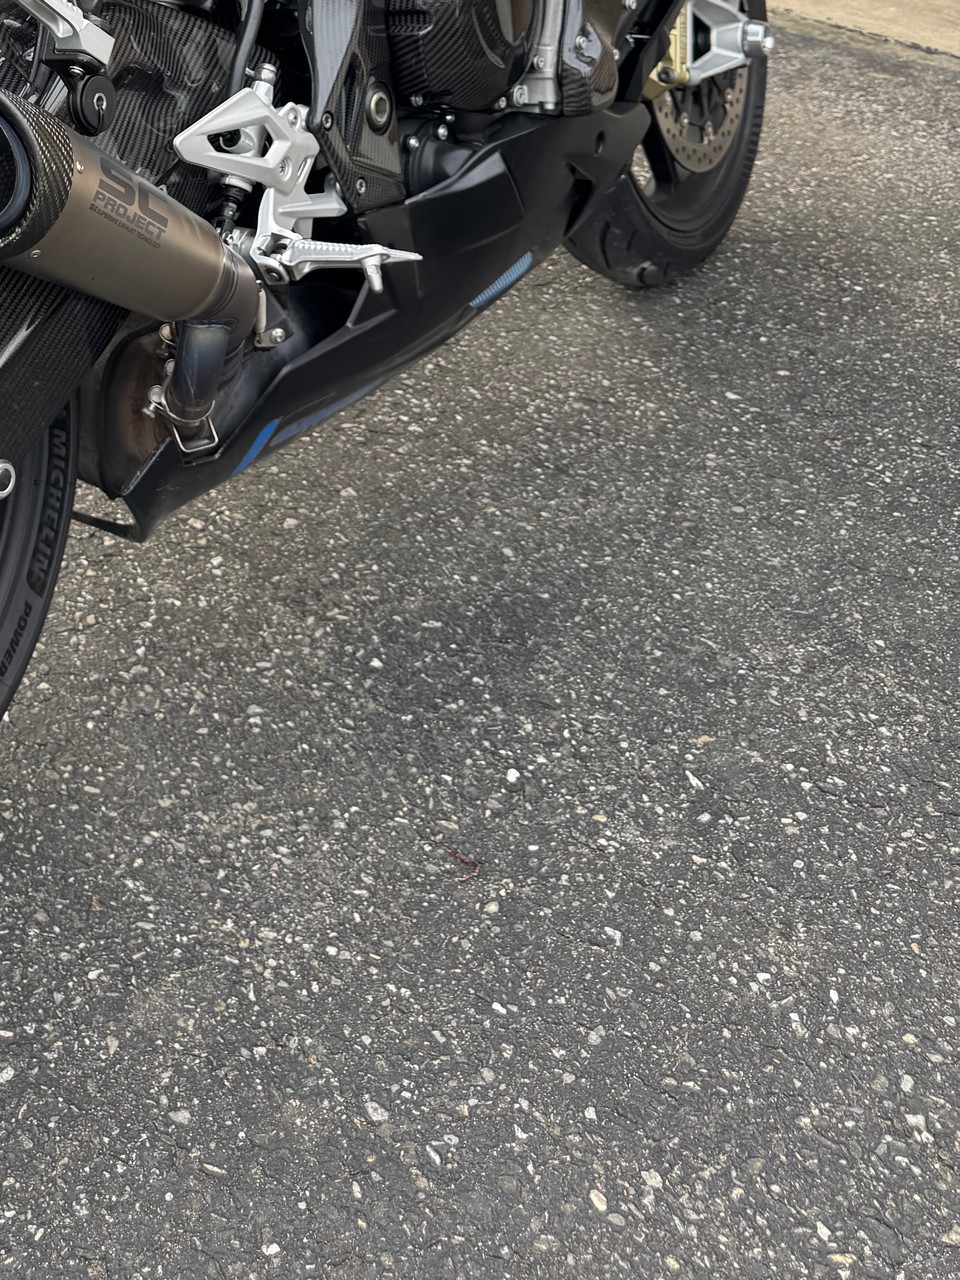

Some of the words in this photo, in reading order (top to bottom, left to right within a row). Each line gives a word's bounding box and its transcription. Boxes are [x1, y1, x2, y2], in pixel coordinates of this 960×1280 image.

[92, 189, 167, 241] PROJECT
[98, 156, 169, 229] SC
[36, 429, 67, 584] MICHELIN
